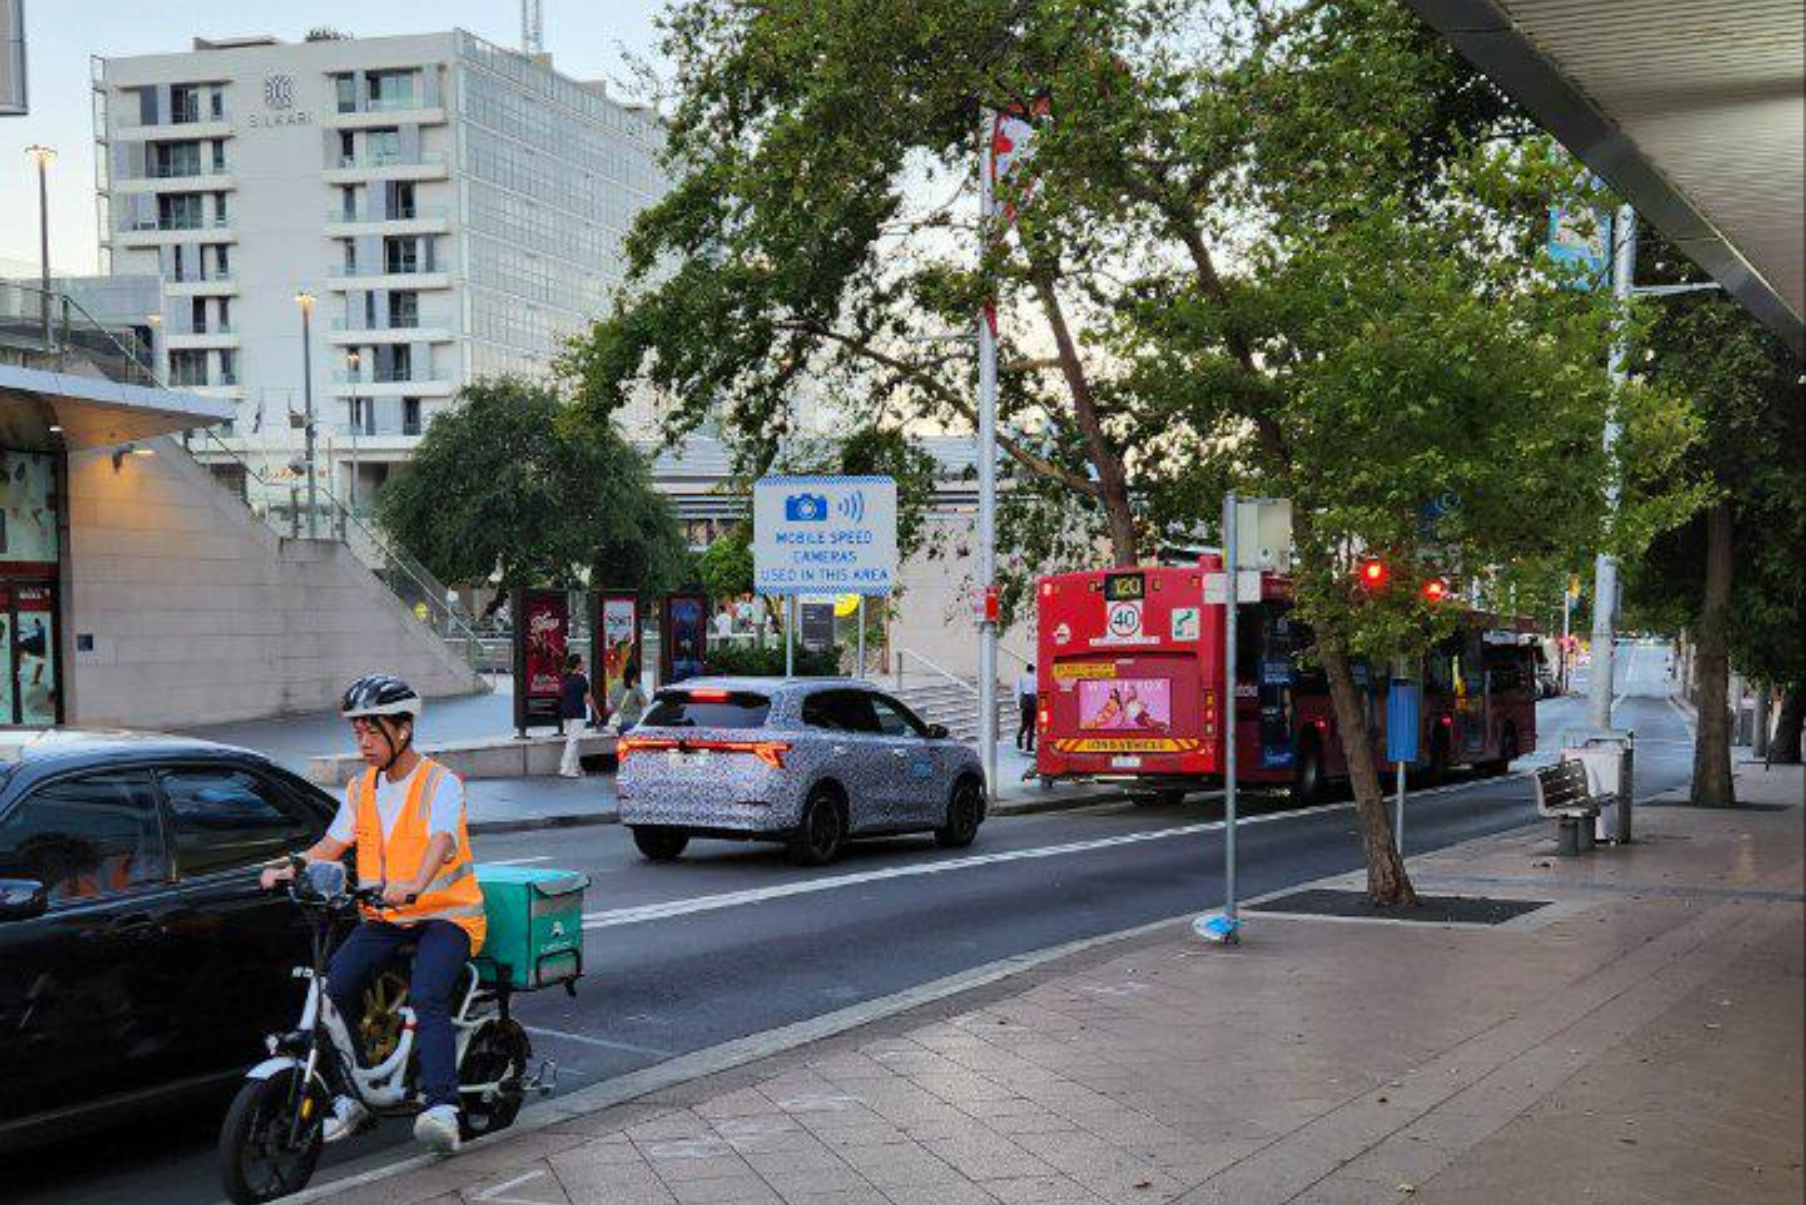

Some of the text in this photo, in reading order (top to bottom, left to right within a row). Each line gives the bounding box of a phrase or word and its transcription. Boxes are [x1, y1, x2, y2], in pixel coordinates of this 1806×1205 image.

[248, 111, 314, 129] SILKARI
[776, 531, 872, 544] MOBILE SPEED
[793, 551, 858, 564] CAMERAS
[761, 567, 889, 582] USED IN THIS AREA
[1113, 610, 1137, 628] 40
